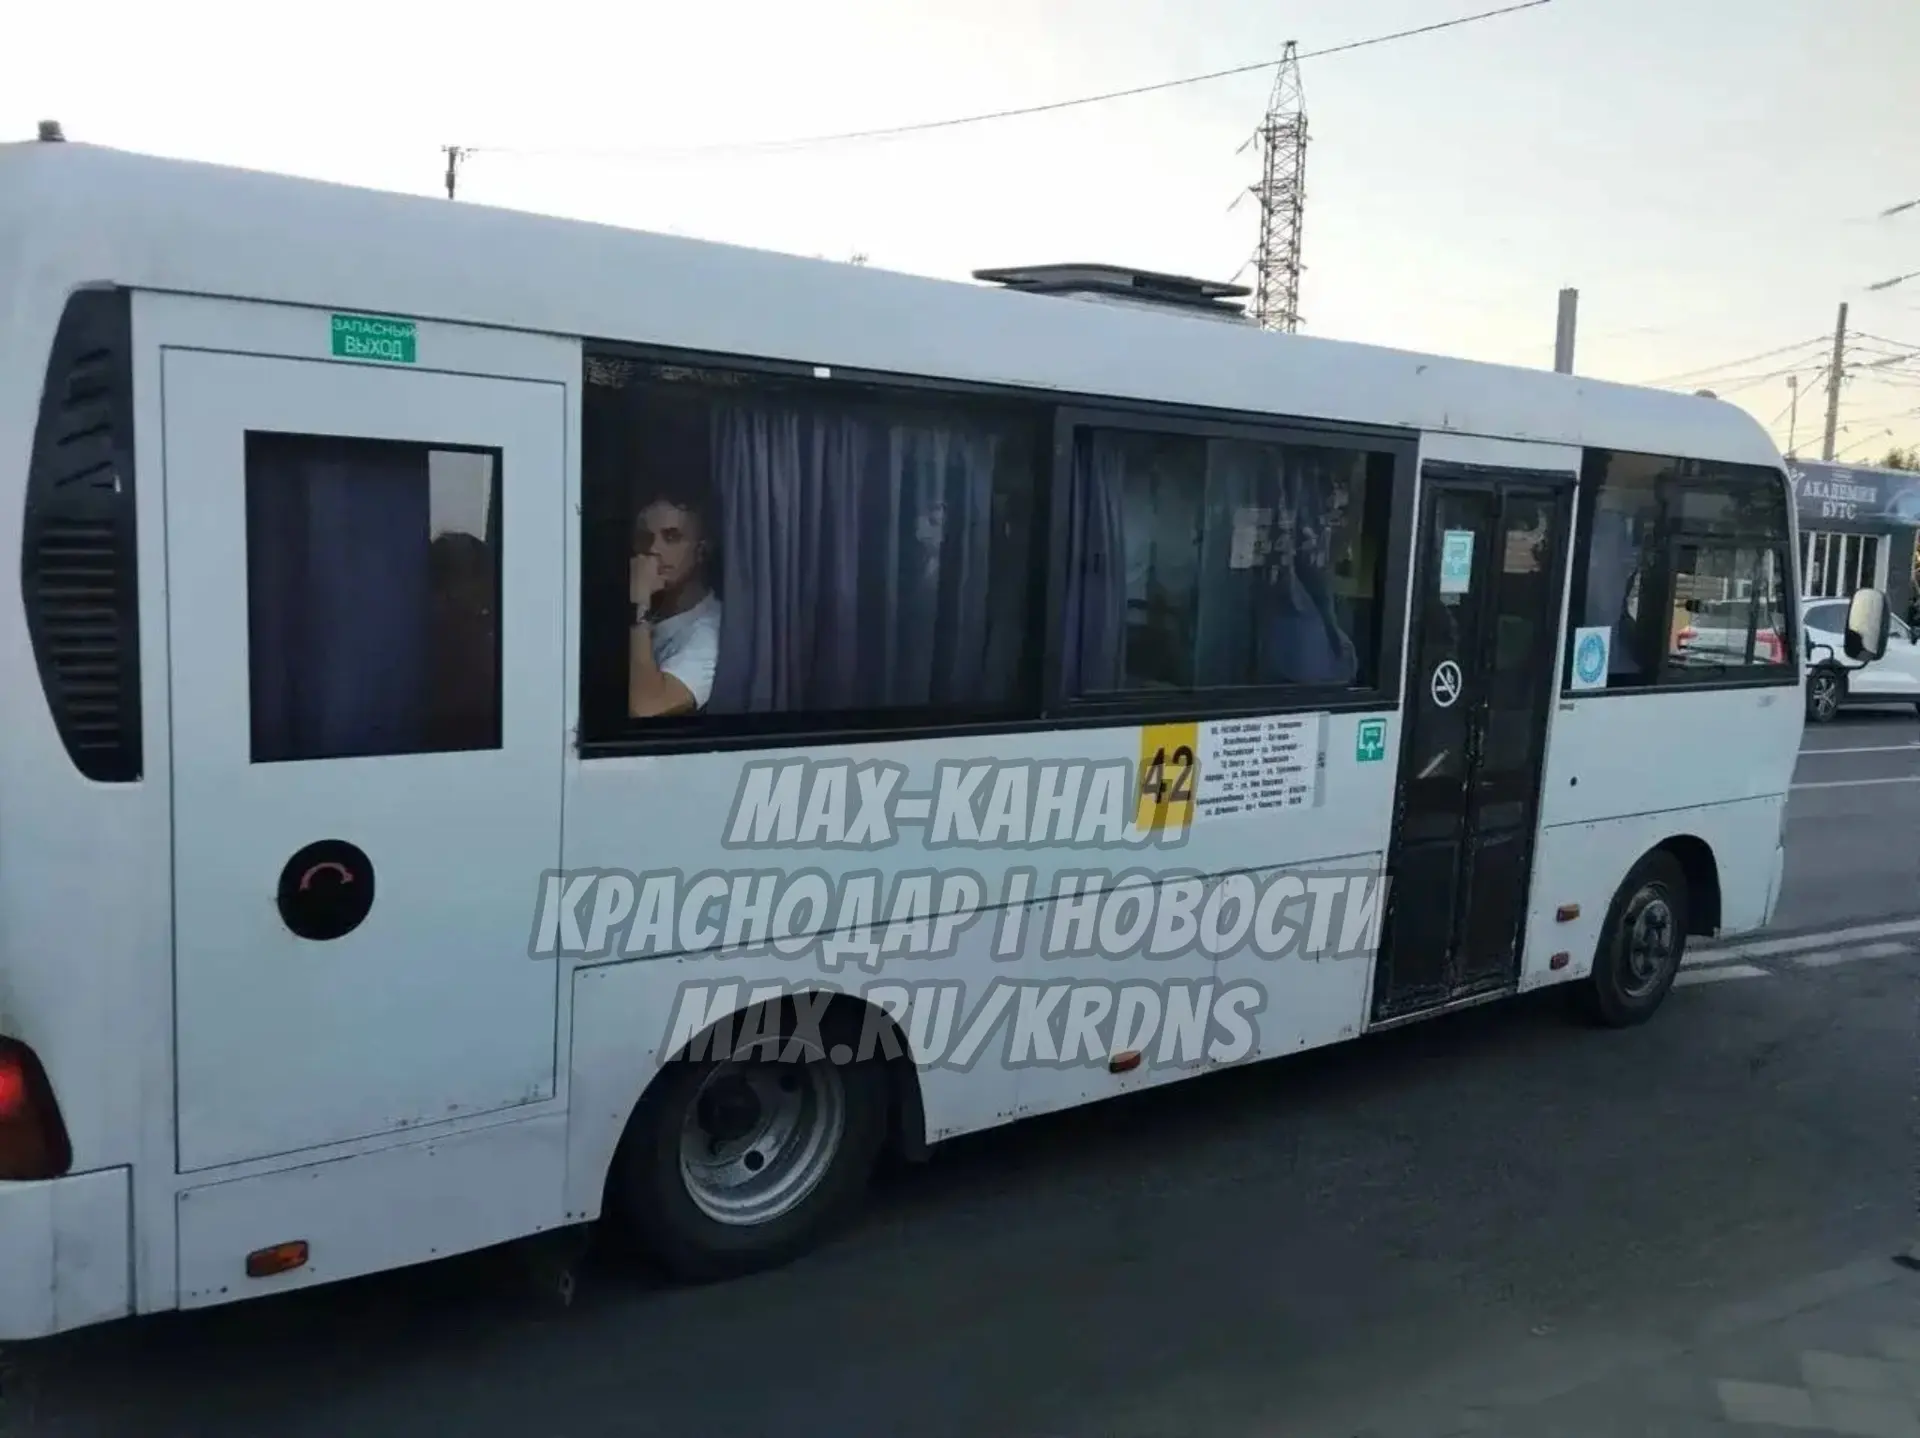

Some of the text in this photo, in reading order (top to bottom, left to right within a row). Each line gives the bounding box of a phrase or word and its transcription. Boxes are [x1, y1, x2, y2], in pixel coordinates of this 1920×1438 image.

[344, 335, 404, 361] ВЫХОД
[1821, 501, 1858, 520] БУТС
[1141, 745, 1194, 804] 42
